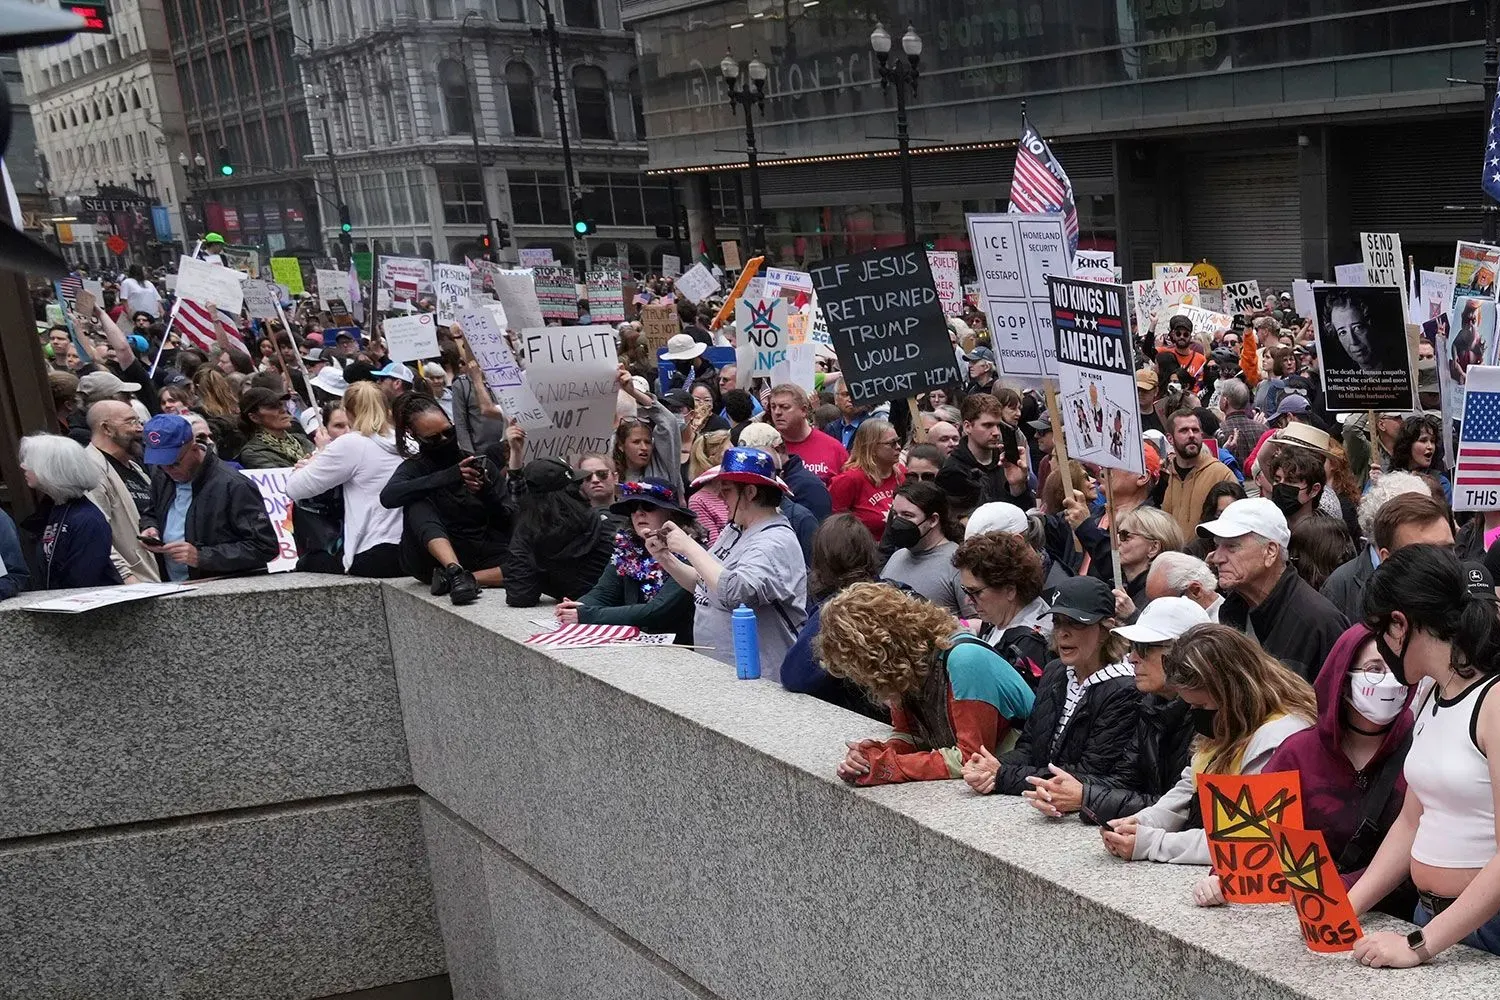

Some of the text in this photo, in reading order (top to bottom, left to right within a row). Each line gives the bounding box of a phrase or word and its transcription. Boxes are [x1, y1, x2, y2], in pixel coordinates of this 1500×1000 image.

[1022, 130, 1046, 155] NO
[984, 235, 1009, 250] ICE
[1022, 231, 1061, 240] HOMELAND
[1366, 233, 1393, 251] SEND
[1028, 244, 1058, 253] SECURITY
[1078, 258, 1110, 269] KING
[1369, 251, 1396, 269] YOUR
[810, 251, 919, 291] IF JESUS
[985, 270, 1019, 281] GESTAPO
[1367, 268, 1397, 286] NAT'L
[1163, 278, 1199, 296] KINGS
[1226, 283, 1248, 299] NO
[826, 287, 936, 323] RETURNED
[1053, 282, 1069, 309] NO
[1070, 285, 1104, 316] KINGS
[1105, 290, 1121, 317] IN
[997, 315, 1027, 329] GOP
[747, 329, 778, 348] NO
[839, 316, 920, 347] TRUMP
[526, 333, 609, 363] FIGHT
[1001, 349, 1037, 360] REICHSTAG
[1059, 328, 1127, 370] AMERICA
[854, 343, 920, 372] WOULD
[850, 366, 960, 401] DEPORT HIM
[549, 406, 590, 430] NOT
[1466, 490, 1499, 506] THIS
[1213, 842, 1275, 871] NO
